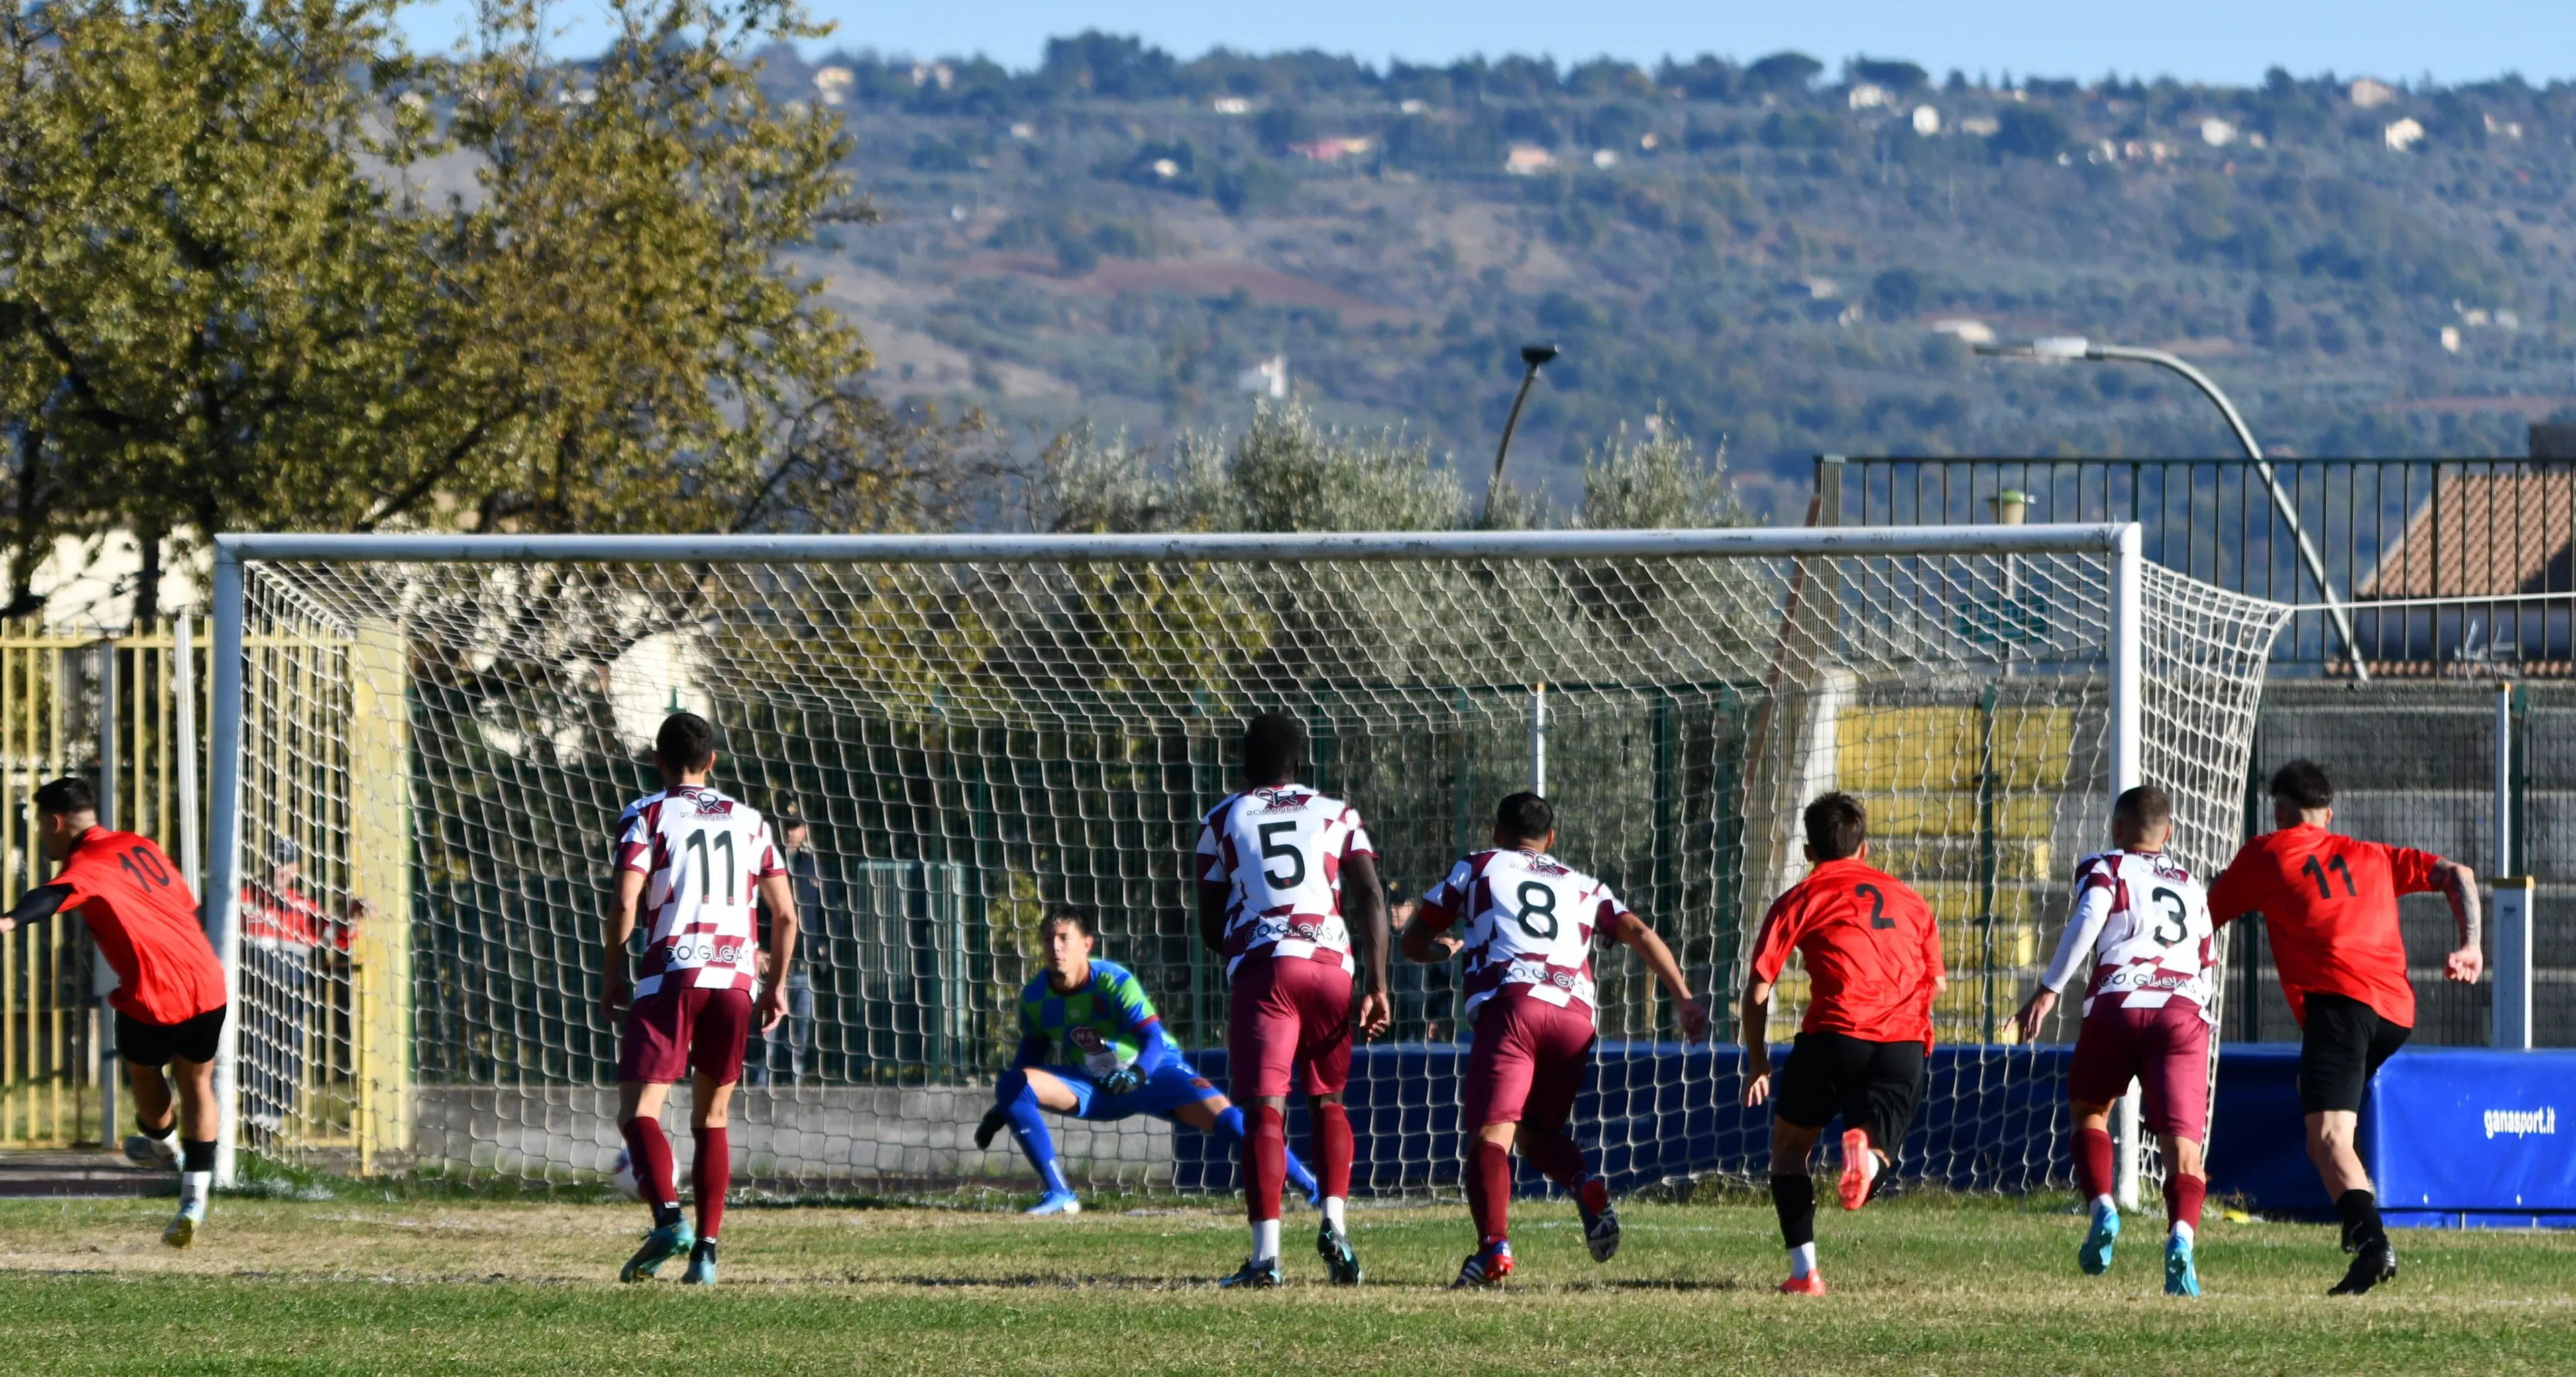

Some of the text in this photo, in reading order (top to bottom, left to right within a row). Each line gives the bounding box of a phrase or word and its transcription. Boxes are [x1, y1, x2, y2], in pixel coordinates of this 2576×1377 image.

[1246, 805, 1309, 816] ROMANERIA
[118, 846, 170, 893] 10
[685, 828, 734, 905] 11
[1257, 820, 1305, 891] 5
[2302, 853, 2357, 899] 11
[1517, 881, 1558, 941] 8
[1855, 884, 1896, 930] 2
[2152, 887, 2188, 948] 3
[2484, 1106, 2556, 1140] ganasport.it
